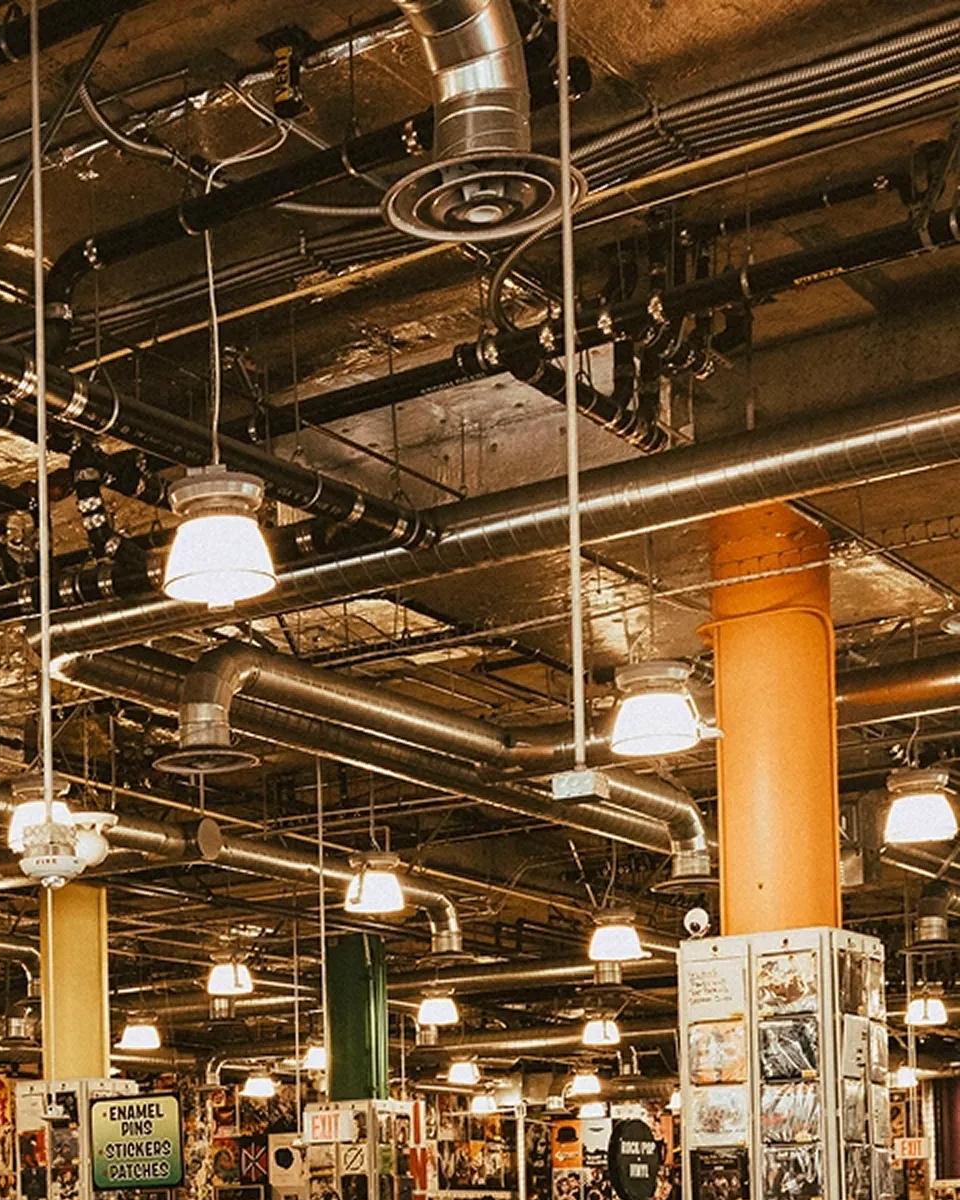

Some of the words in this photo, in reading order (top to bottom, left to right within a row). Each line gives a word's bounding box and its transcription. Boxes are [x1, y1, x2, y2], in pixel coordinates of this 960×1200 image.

[108, 1102, 165, 1122] ENAMEL
[120, 1119, 154, 1137] PINS
[311, 1113, 340, 1140] EXIT
[104, 1138, 172, 1160] STICKERS
[901, 1140, 922, 1157] EXIT
[108, 1161, 170, 1180] PATCHES
